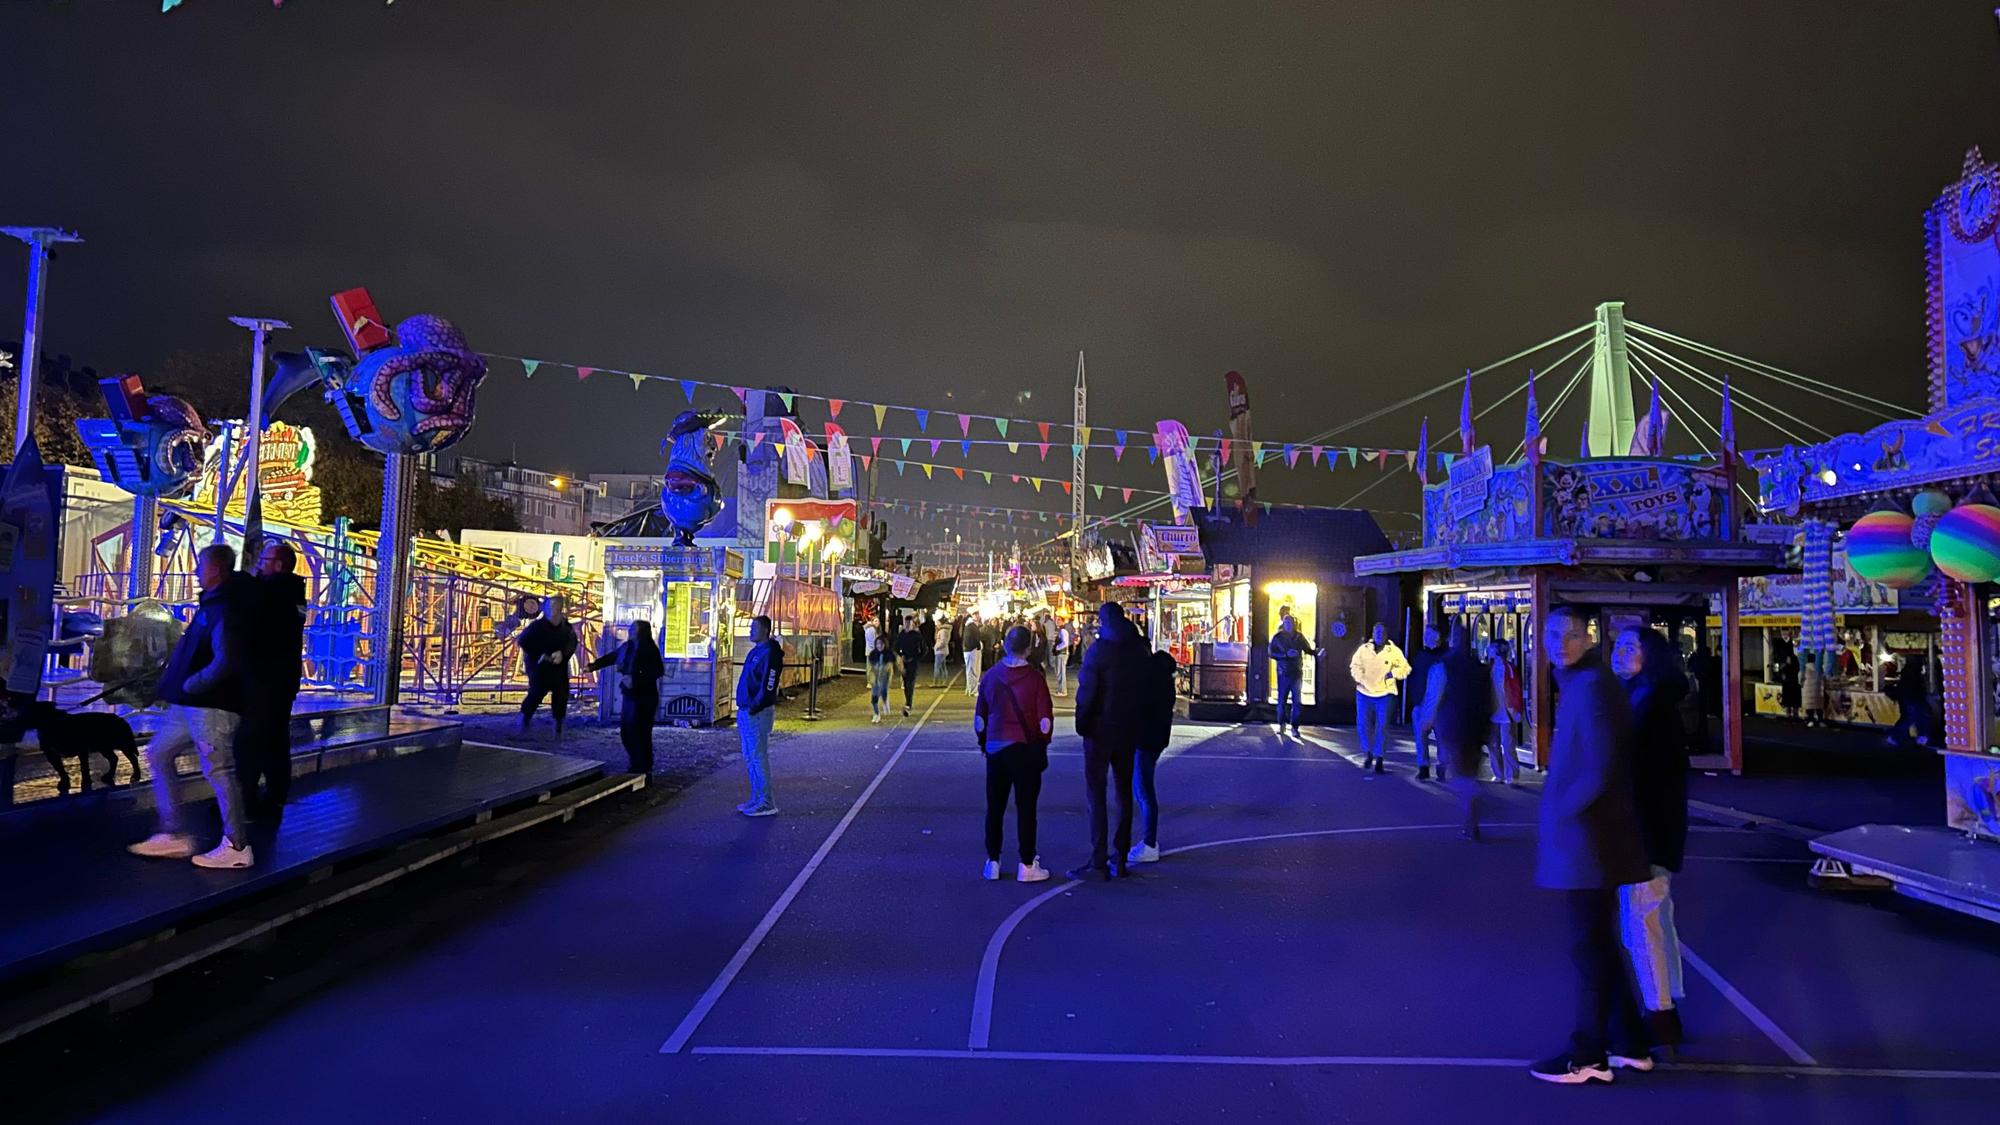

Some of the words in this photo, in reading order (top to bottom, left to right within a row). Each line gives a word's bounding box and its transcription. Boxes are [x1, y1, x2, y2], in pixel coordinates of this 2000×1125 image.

[1590, 468, 1660, 500] XXL
[1631, 490, 1678, 512] TOYS
[766, 669, 777, 691] CREW
